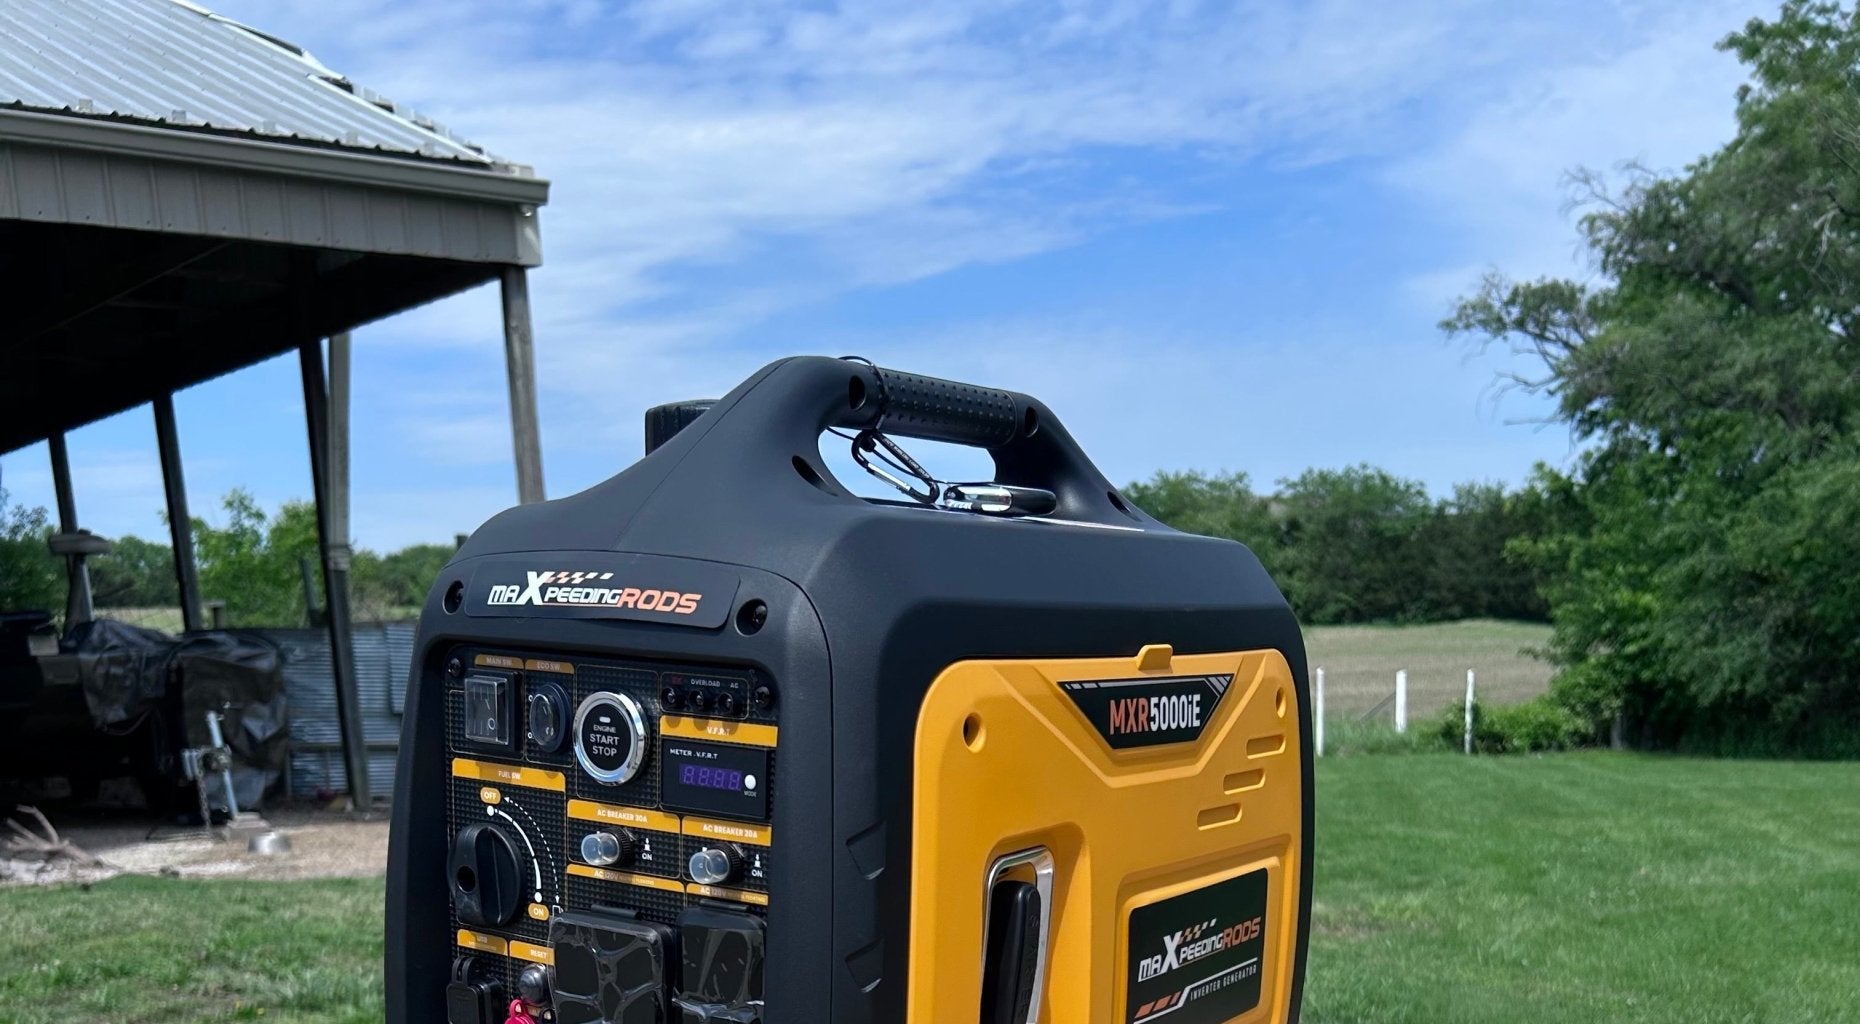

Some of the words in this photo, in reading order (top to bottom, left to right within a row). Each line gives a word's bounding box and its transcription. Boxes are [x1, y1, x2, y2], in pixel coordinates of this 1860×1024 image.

[690, 678, 720, 687] OVERLOAD
[593, 724, 616, 733] ENGINE
[590, 734, 620, 745] START
[592, 746, 617, 756] STOP
[670, 748, 692, 757] METER
[483, 791, 497, 800] OFF
[597, 808, 606, 817] AC
[607, 809, 634, 821] BREAKER
[703, 823, 712, 832] AC
[714, 825, 743, 837] BREAKER
[642, 853, 653, 861] ON
[594, 870, 604, 878] AC
[752, 869, 763, 877] ON
[700, 887, 711, 896] AC
[533, 908, 544, 916] ON
[1190, 980, 1221, 1001] INVERTER
[1223, 964, 1257, 987] GENERATOR
